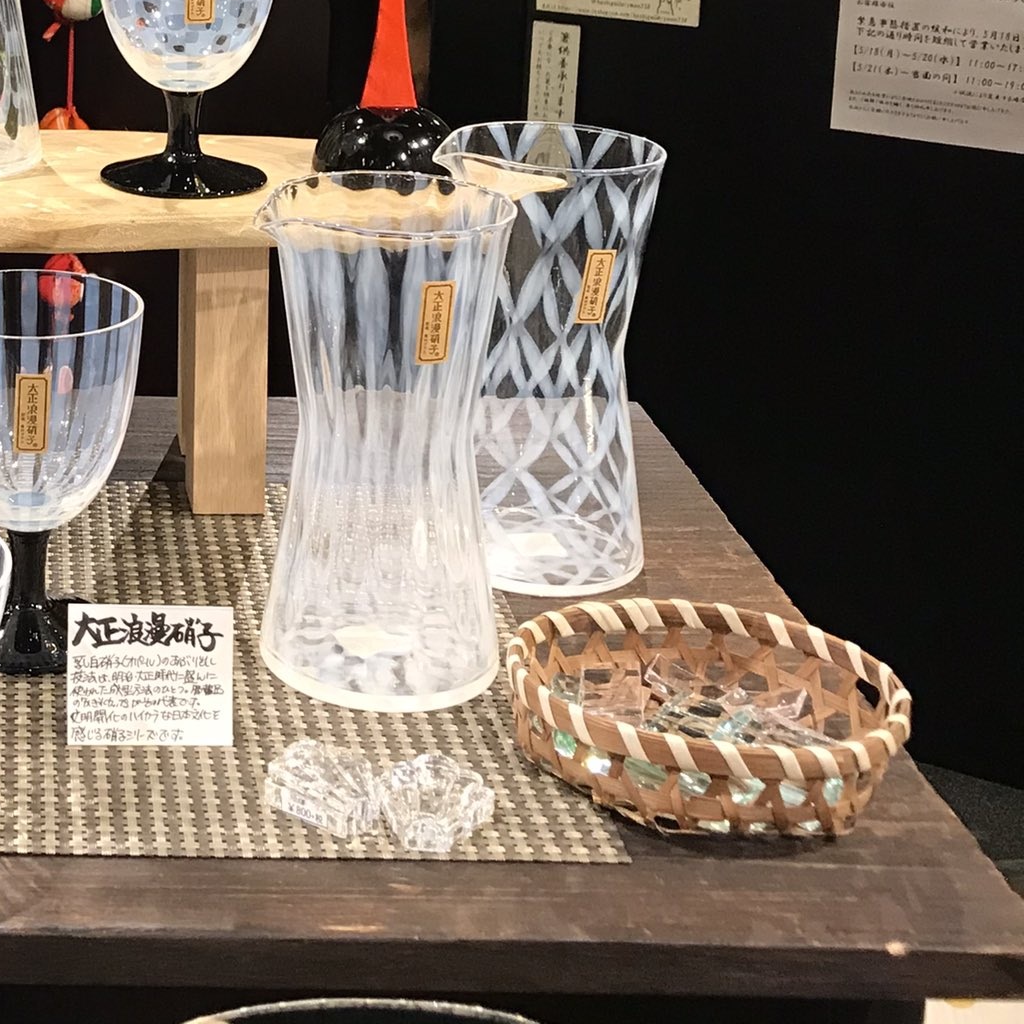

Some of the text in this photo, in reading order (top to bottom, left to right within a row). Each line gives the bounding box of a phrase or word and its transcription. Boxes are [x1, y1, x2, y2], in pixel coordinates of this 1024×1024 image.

[587, 258, 606, 316] 大正浪漫硝子
[429, 291, 444, 356] 大正浪漫硝子
[26, 383, 39, 446] 大正浪漫硝子
[71, 611, 224, 652] 大正浪漫硝子
